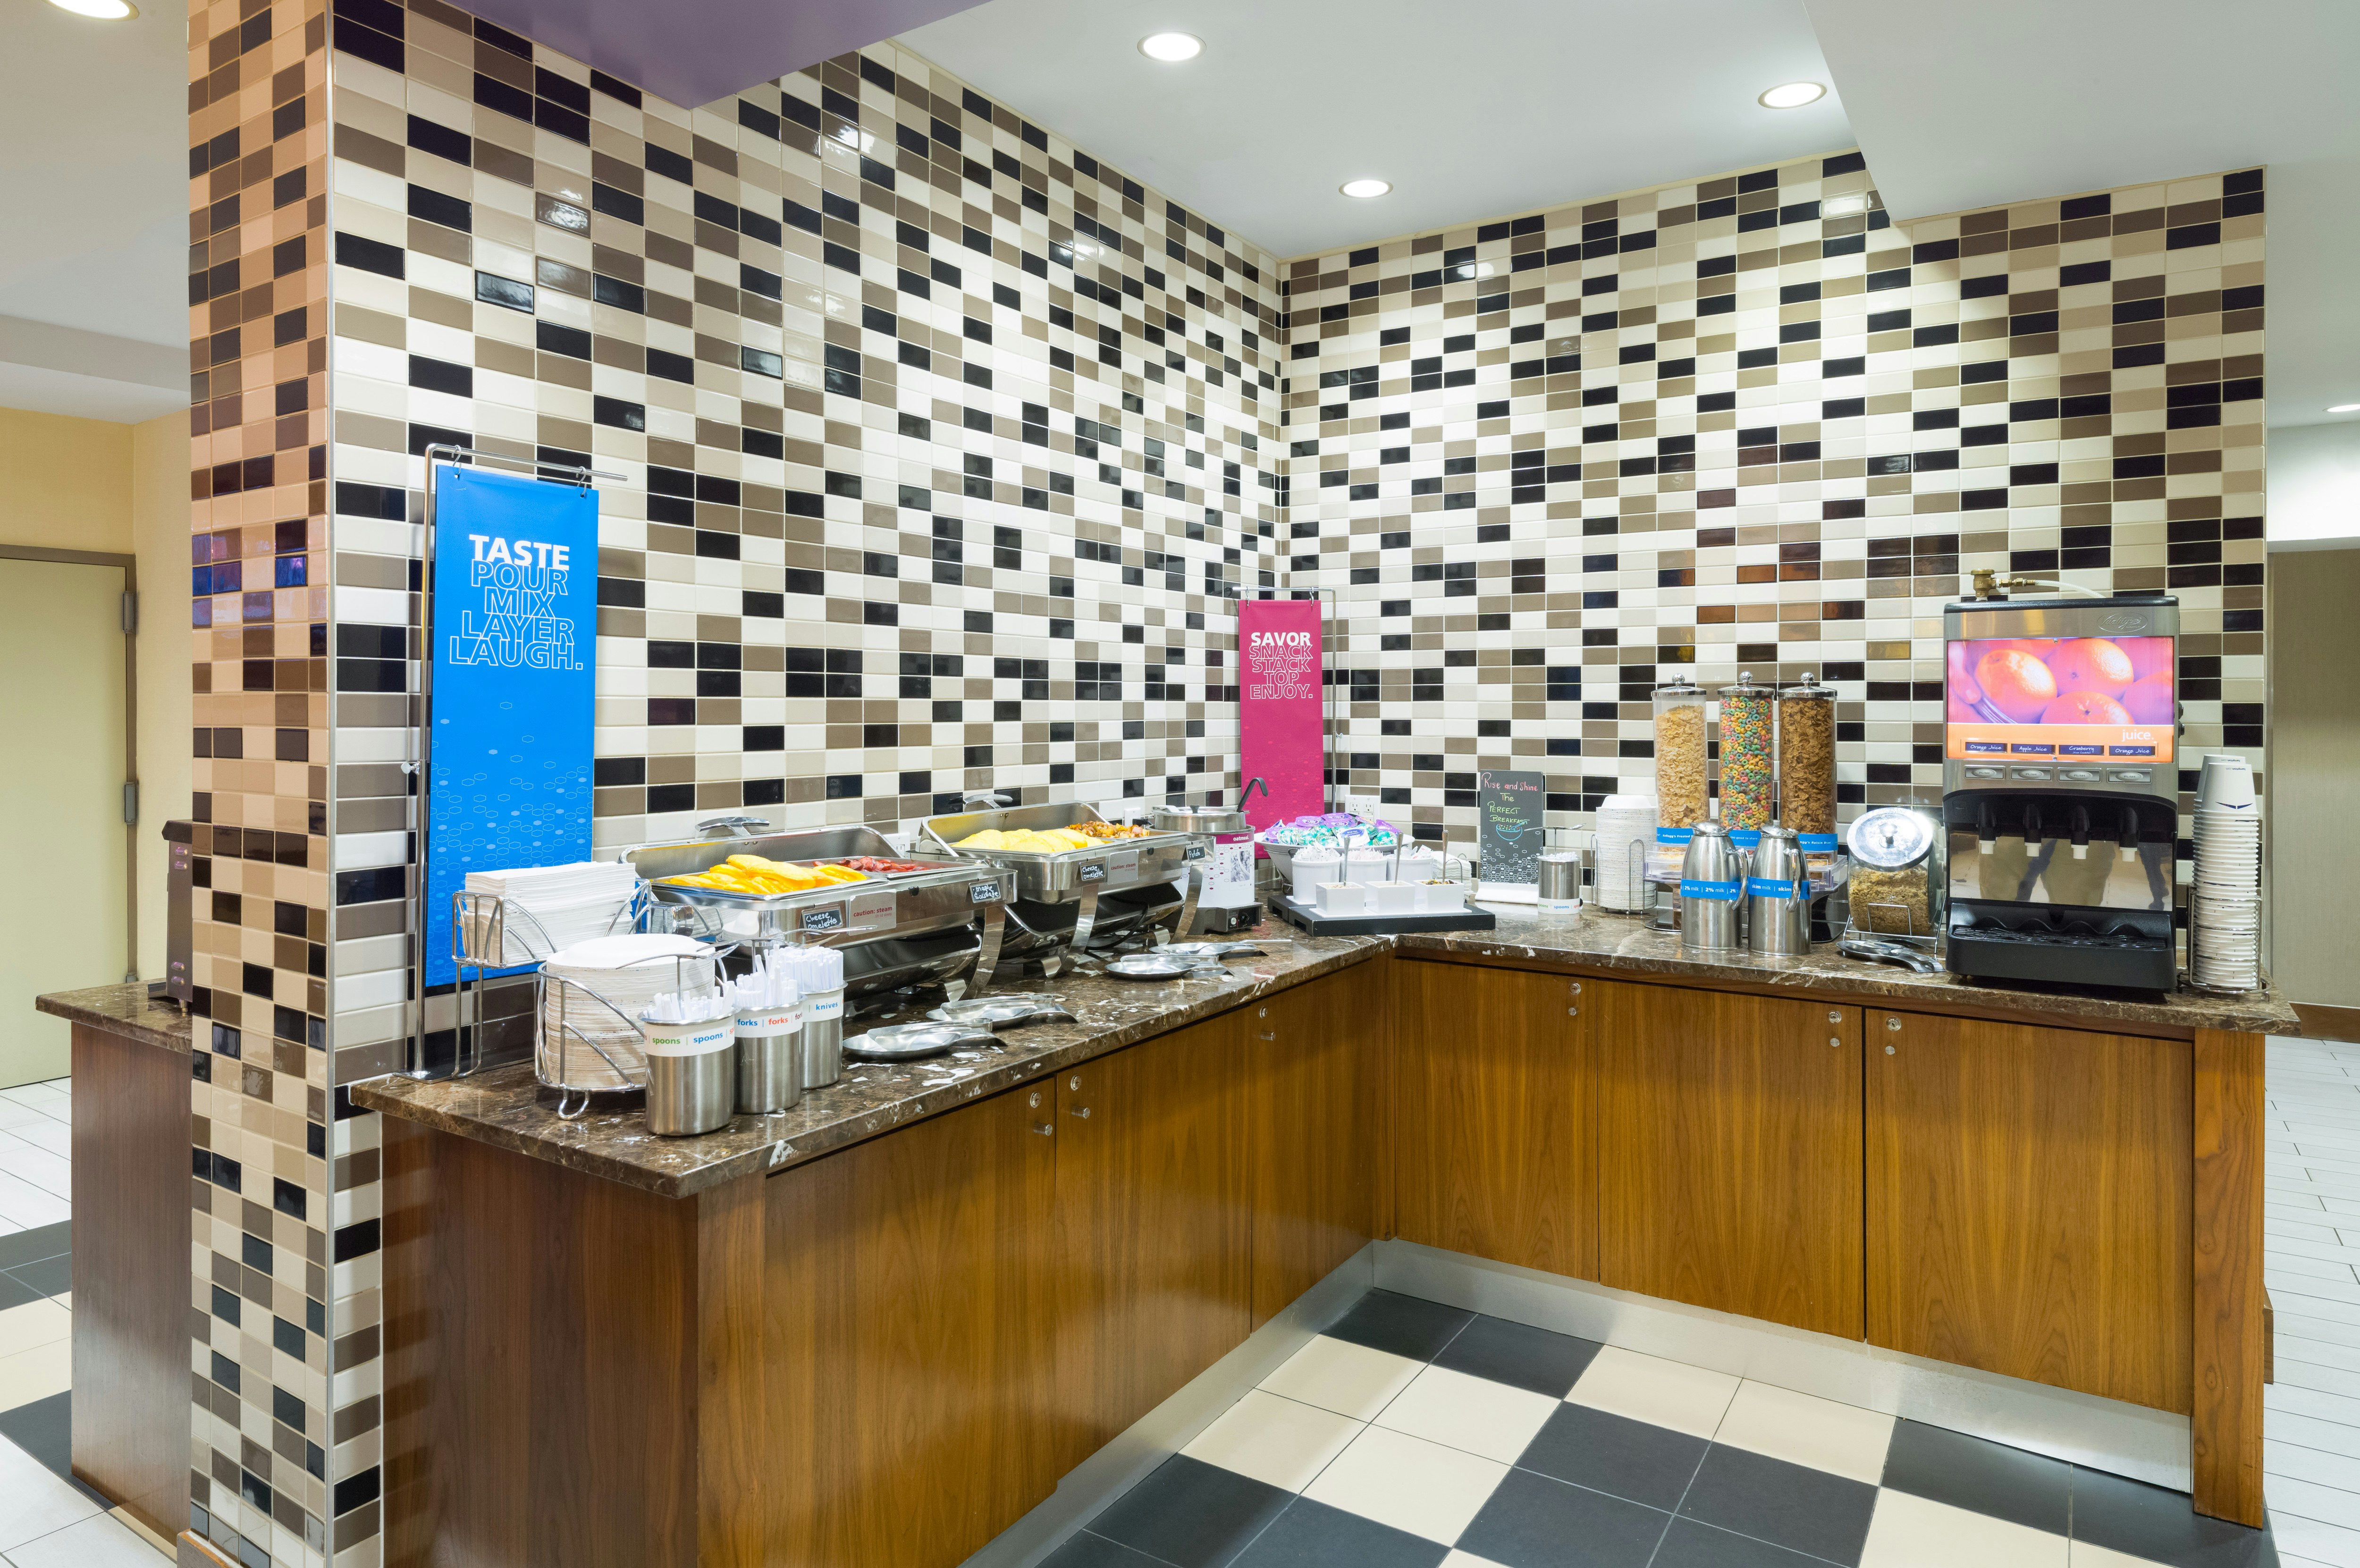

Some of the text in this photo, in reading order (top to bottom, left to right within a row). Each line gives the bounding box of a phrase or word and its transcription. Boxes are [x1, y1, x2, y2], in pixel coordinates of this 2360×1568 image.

[469, 534, 569, 570] TASTE
[472, 559, 568, 595] POUR
[485, 586, 555, 619] MIX
[462, 610, 574, 645] LAYER
[1251, 632, 1311, 646] SAVOR
[449, 636, 583, 670] LAUGH.
[1249, 644, 1313, 659] SNACK
[1252, 658, 1311, 673] STACK
[1264, 671, 1299, 685] TOP
[1250, 684, 1313, 699] ENJOY.
[2121, 729, 2154, 742] juice.
[1482, 772, 1538, 791] Rise and Shine
[1500, 793, 1514, 801] The
[1487, 801, 1520, 814] PERFECT
[1490, 815, 1530, 825] BREAKFAST
[806, 912, 830, 922] Cheese
[853, 909, 875, 917] caution:
[816, 1002, 838, 1011] knives
[693, 1033, 723, 1044] spoons
